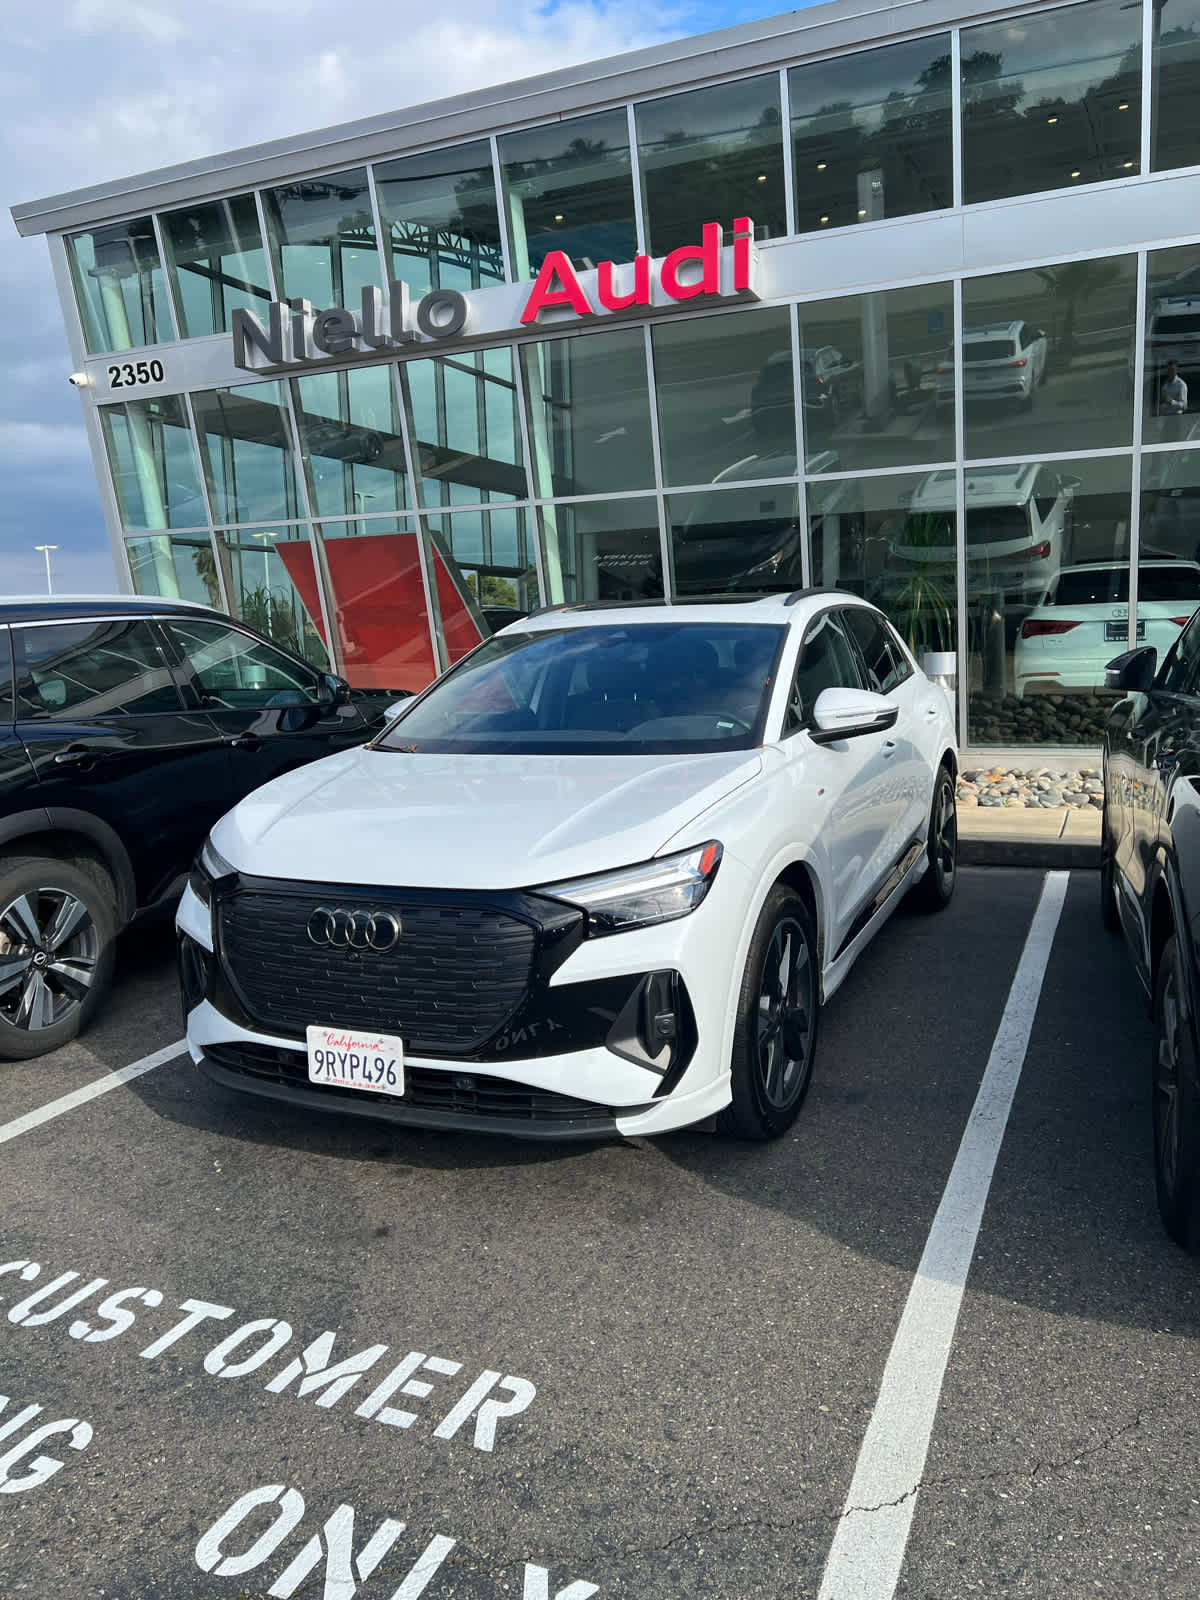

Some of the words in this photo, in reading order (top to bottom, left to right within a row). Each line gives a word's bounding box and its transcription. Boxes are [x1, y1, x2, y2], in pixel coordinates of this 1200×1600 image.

[232, 280, 468, 368] Niello
[520, 216, 751, 323] Audi
[108, 360, 164, 388] 2350
[326, 1032, 385, 1052] California
[314, 1049, 396, 1085] 9RYP496
